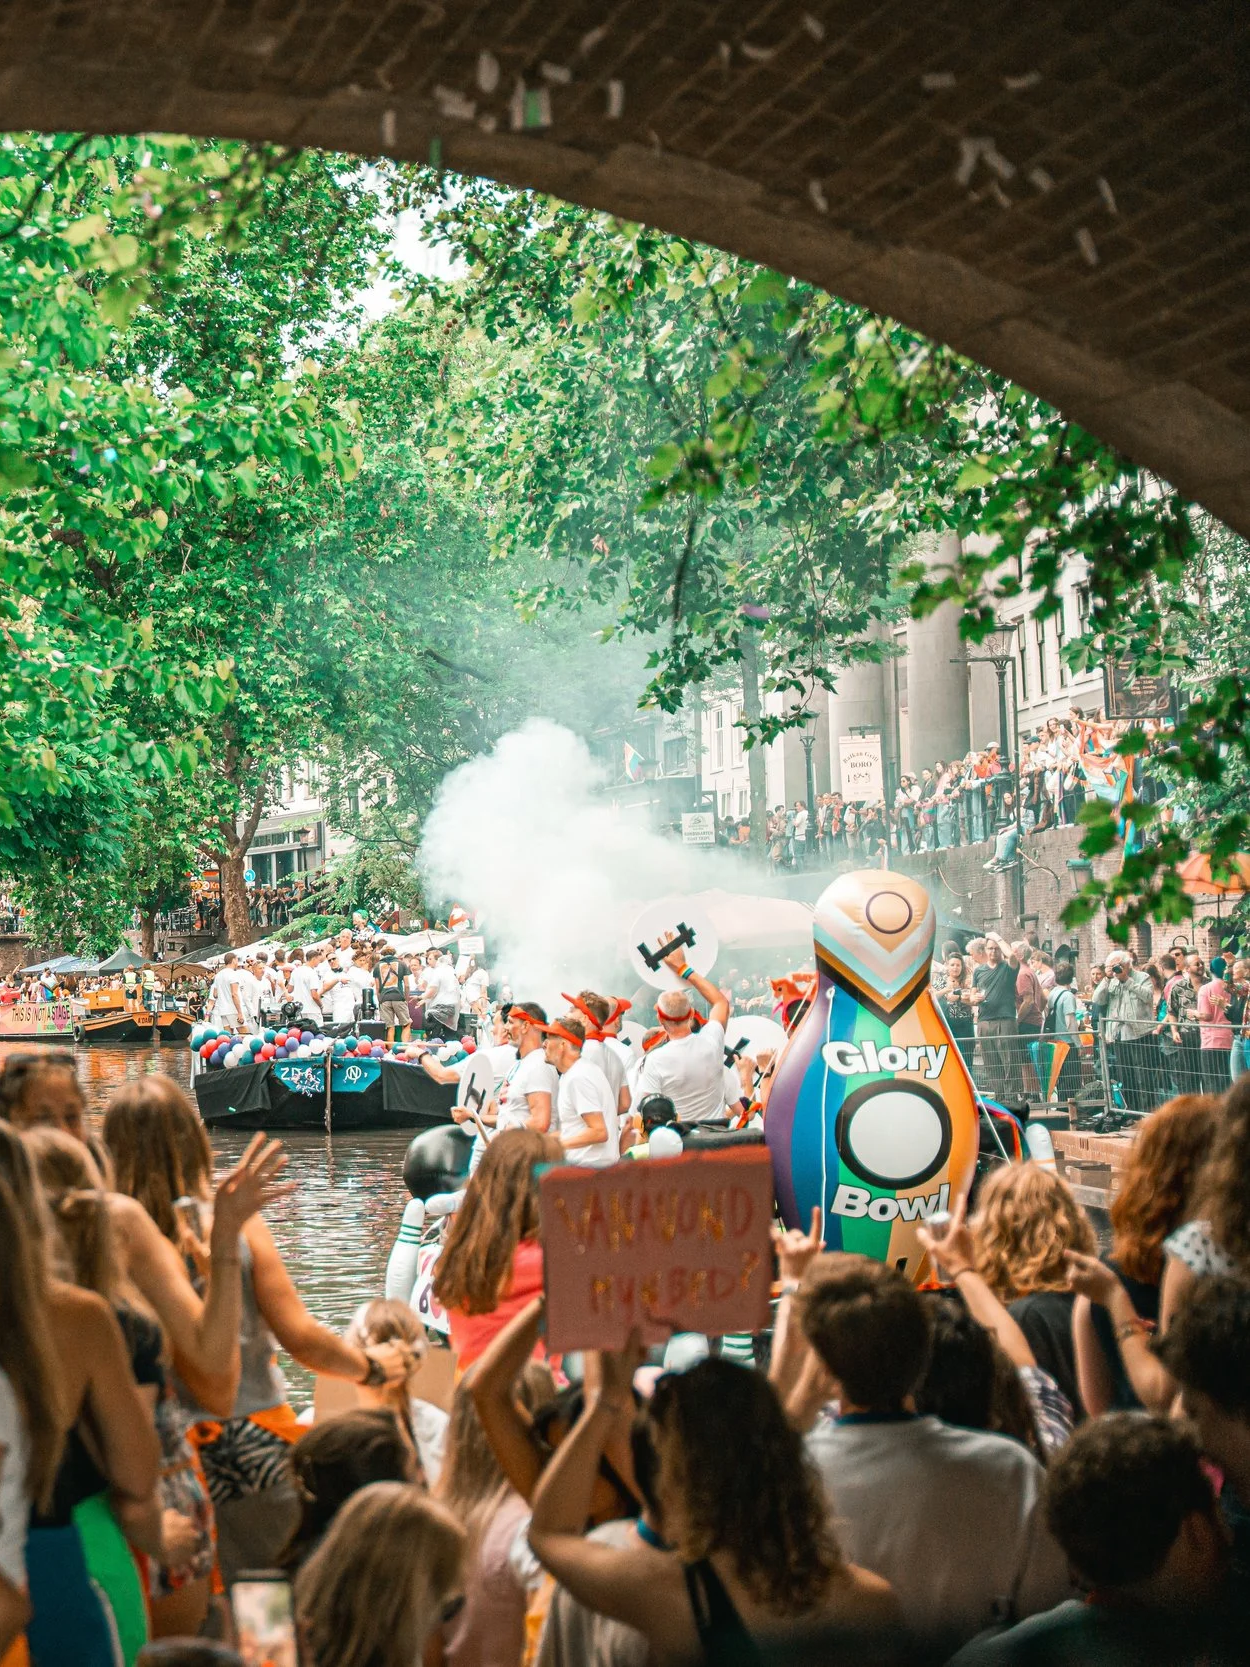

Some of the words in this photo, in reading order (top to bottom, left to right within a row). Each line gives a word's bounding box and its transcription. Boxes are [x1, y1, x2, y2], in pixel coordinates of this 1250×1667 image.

[12, 1007, 24, 1022] THIS
[24, 1006, 31, 1021] IS
[51, 1004, 70, 1021] STAGE
[822, 1040, 949, 1080] Glory
[830, 1183, 951, 1223] Bowl
